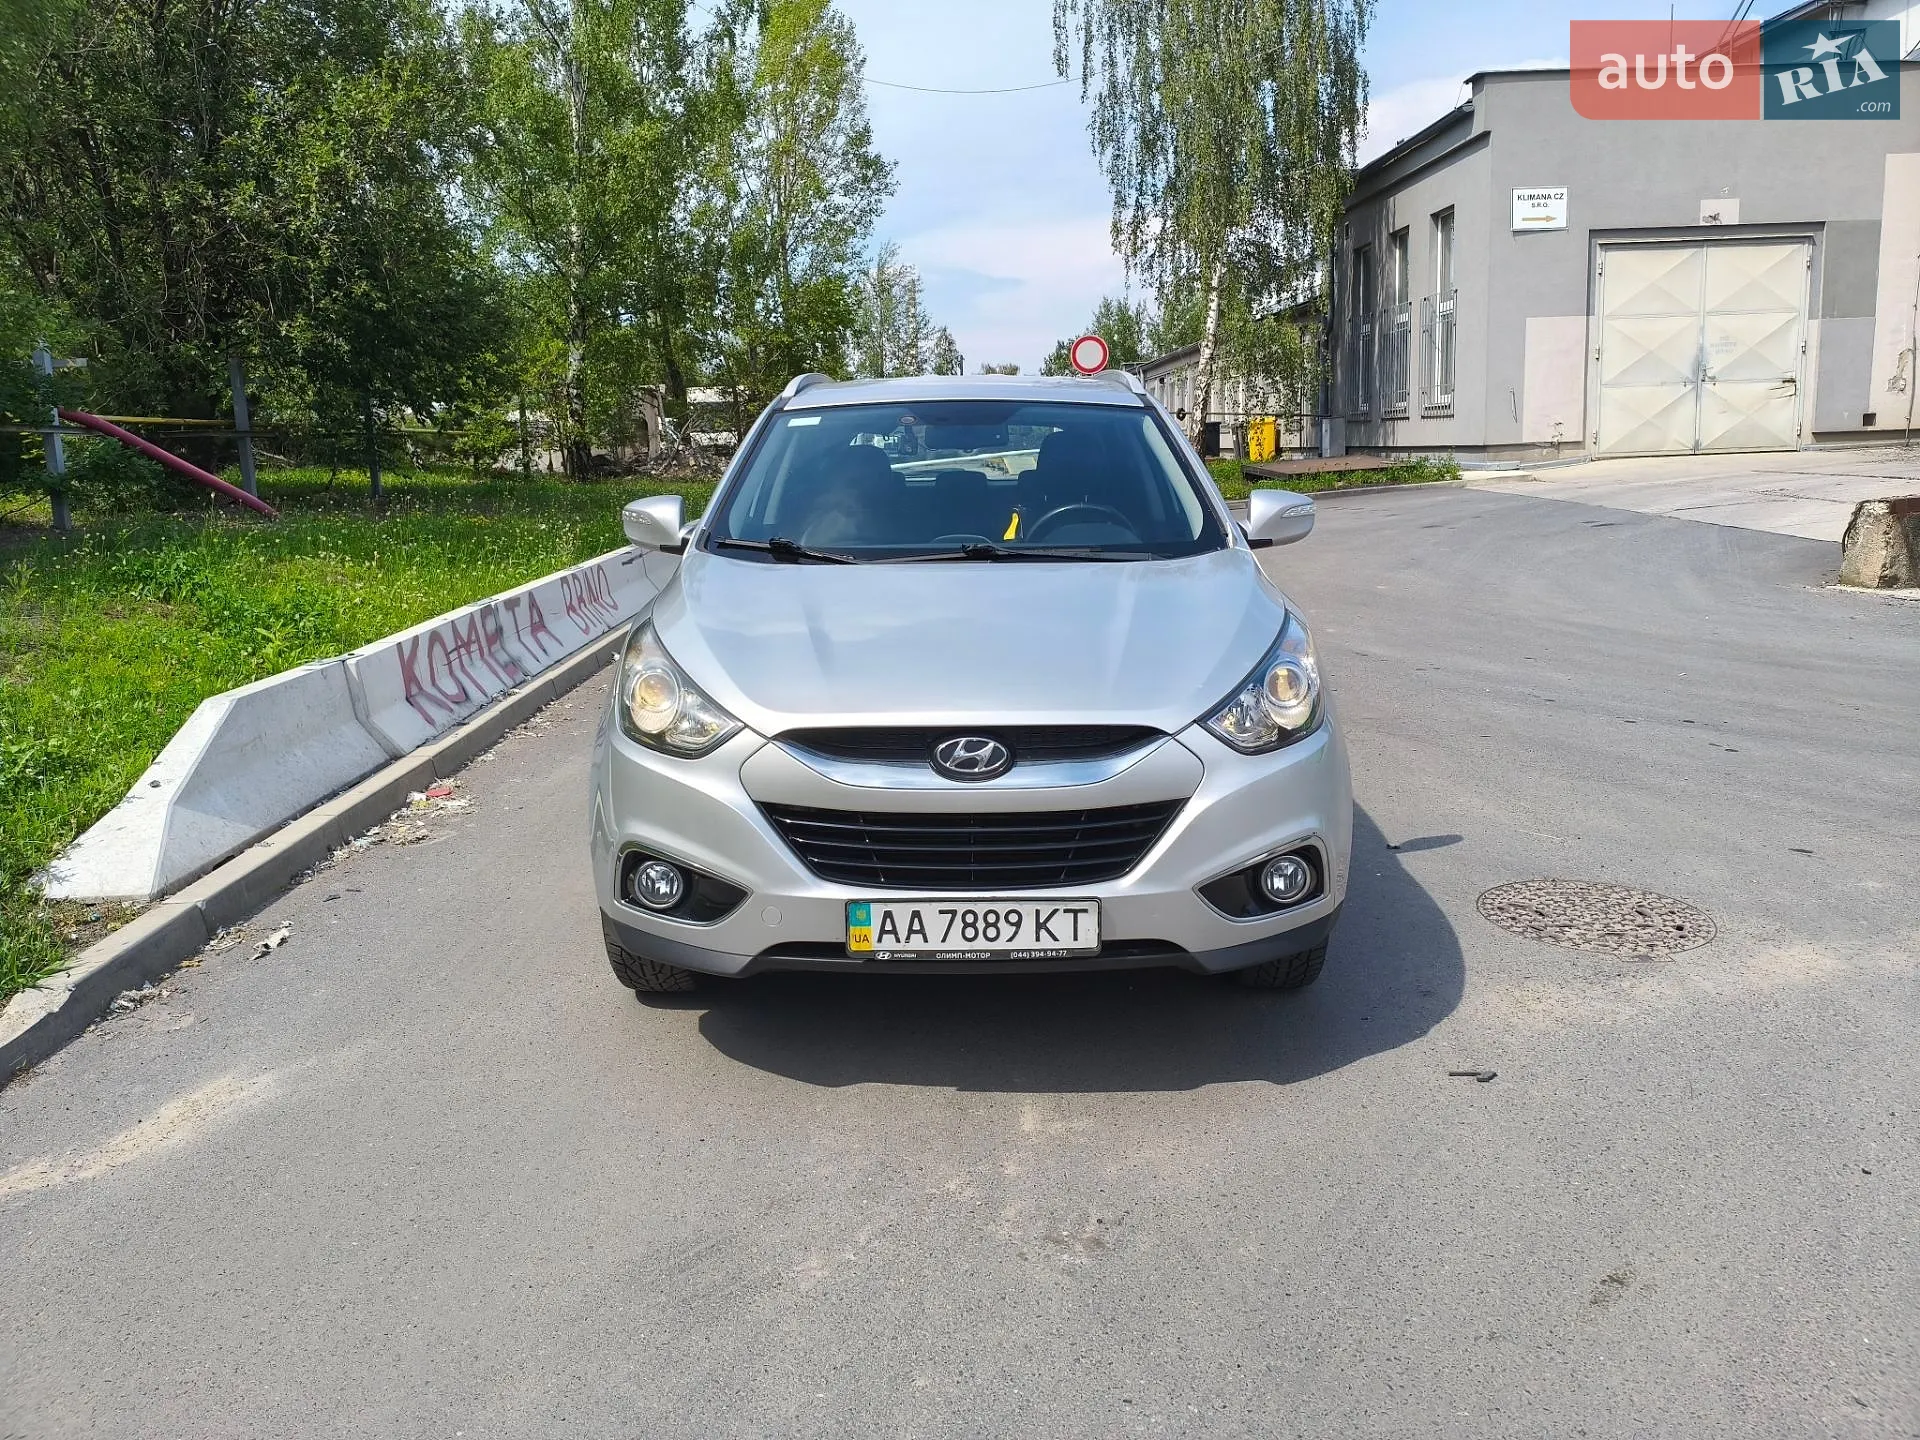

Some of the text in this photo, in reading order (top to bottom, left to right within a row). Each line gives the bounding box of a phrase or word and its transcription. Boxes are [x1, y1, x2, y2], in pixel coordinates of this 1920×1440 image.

[876, 907, 1089, 944] AA 7889 KT
[854, 934, 870, 944] UA
[935, 952, 991, 960] ОЛИМП-МОТОР
[1010, 951, 1030, 960] (044)
